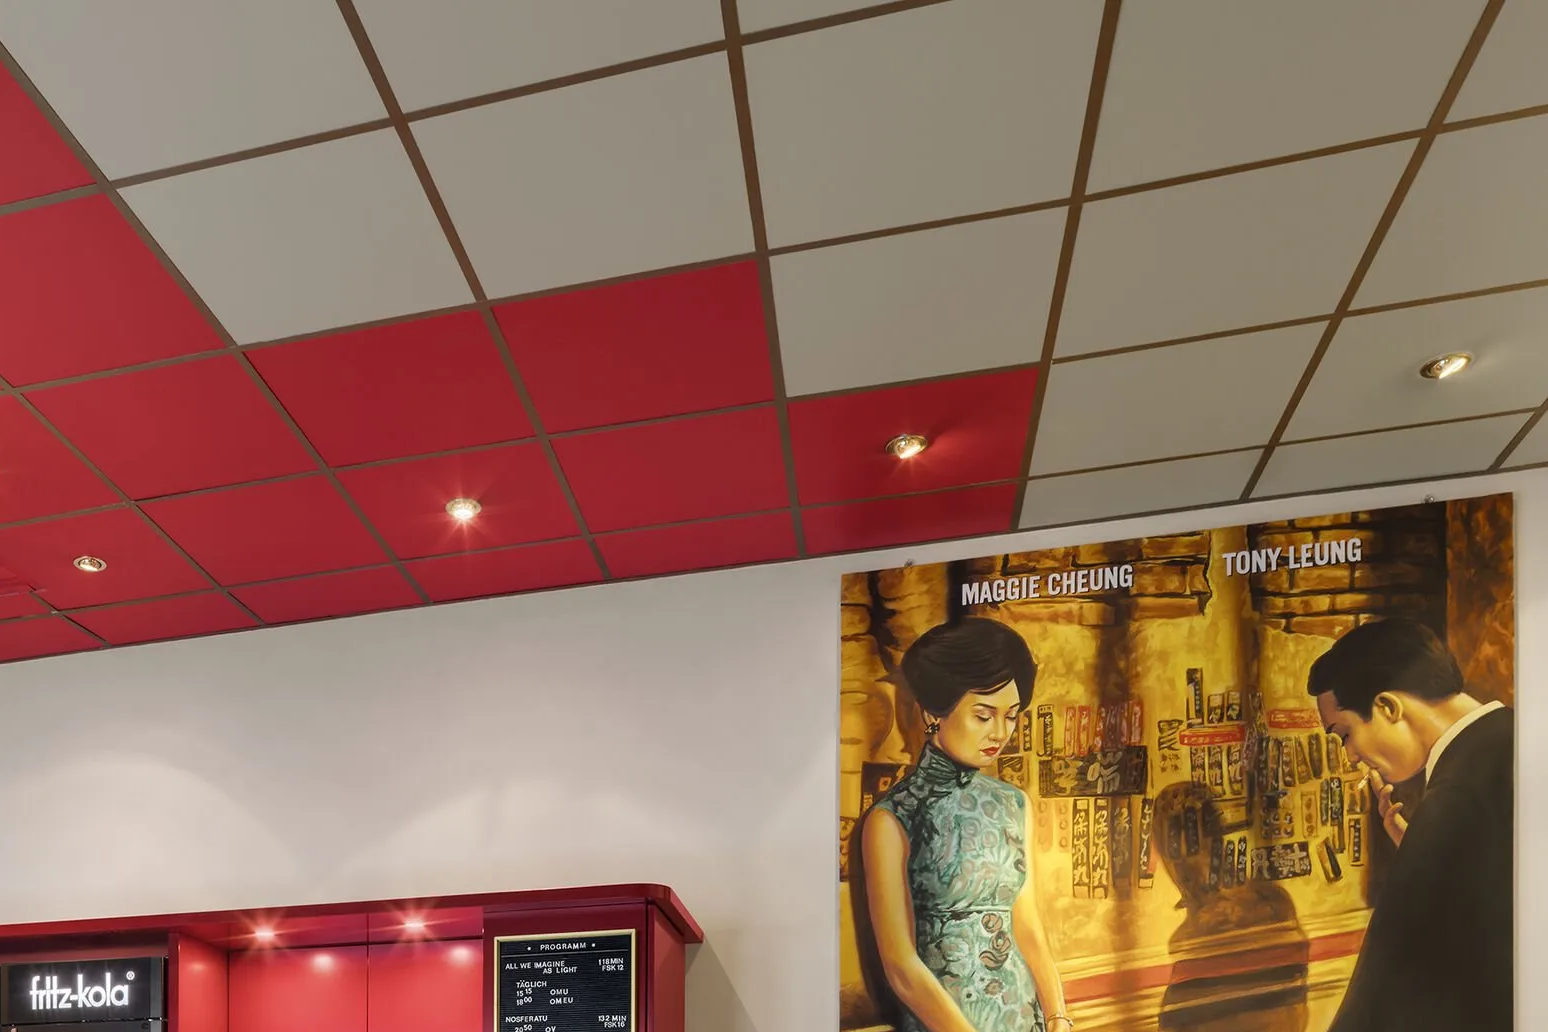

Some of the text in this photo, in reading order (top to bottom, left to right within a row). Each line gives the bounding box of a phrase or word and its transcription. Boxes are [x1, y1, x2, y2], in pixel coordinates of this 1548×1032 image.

[1222, 538, 1362, 577] TONY LEUNG
[962, 564, 1133, 606] MAGGIE CHEUNG
[540, 942, 586, 951] PROGRAMM
[534, 961, 565, 969] IMAGINE
[30, 972, 129, 1011] fritz-kola
[516, 980, 547, 988] TÄGLICH
